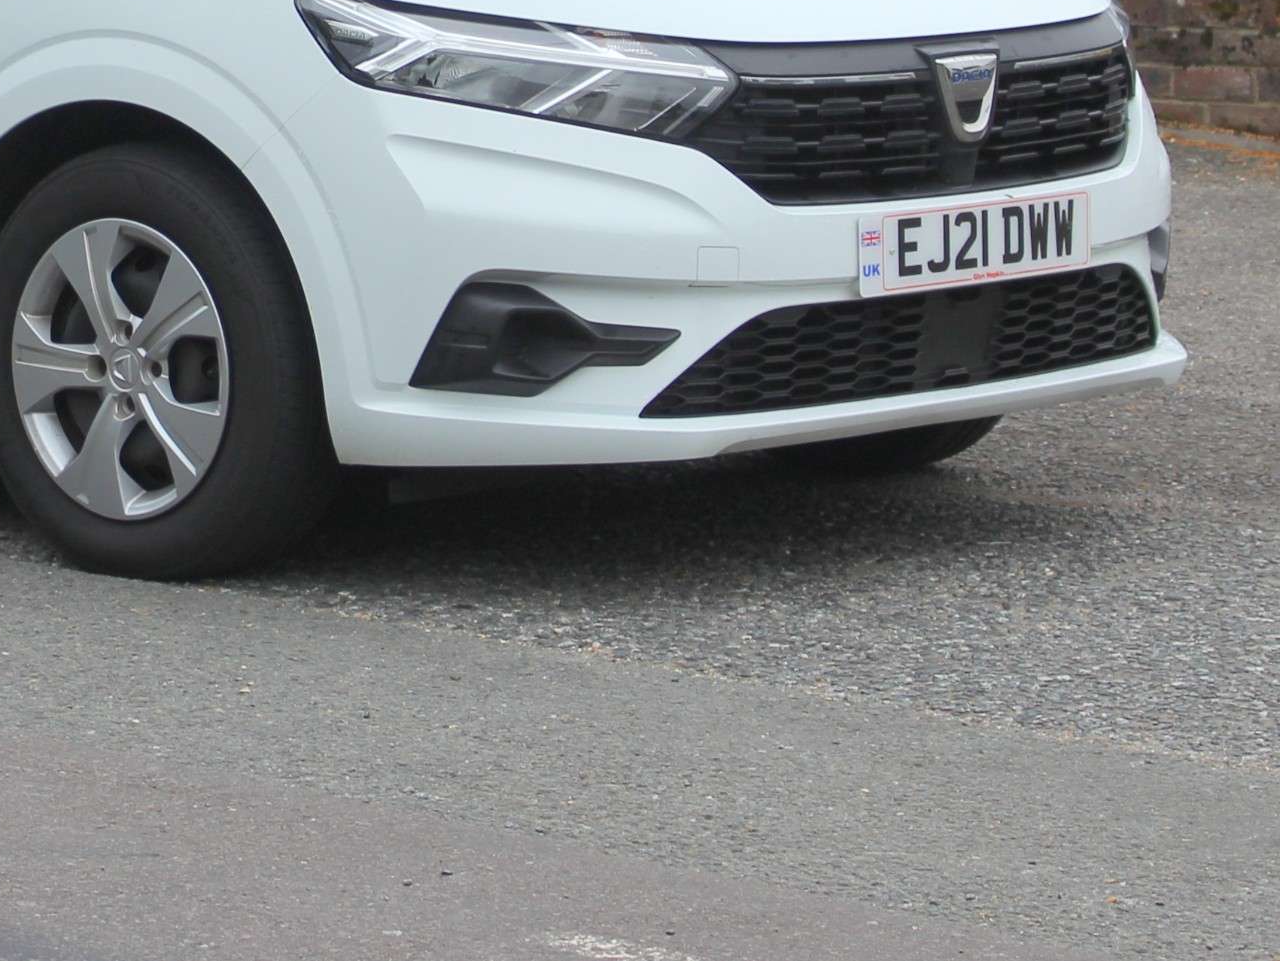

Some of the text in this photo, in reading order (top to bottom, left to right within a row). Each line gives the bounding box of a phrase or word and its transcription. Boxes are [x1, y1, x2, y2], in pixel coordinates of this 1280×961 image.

[898, 198, 1074, 277] EJ21 DWW
[862, 263, 881, 278] UK
